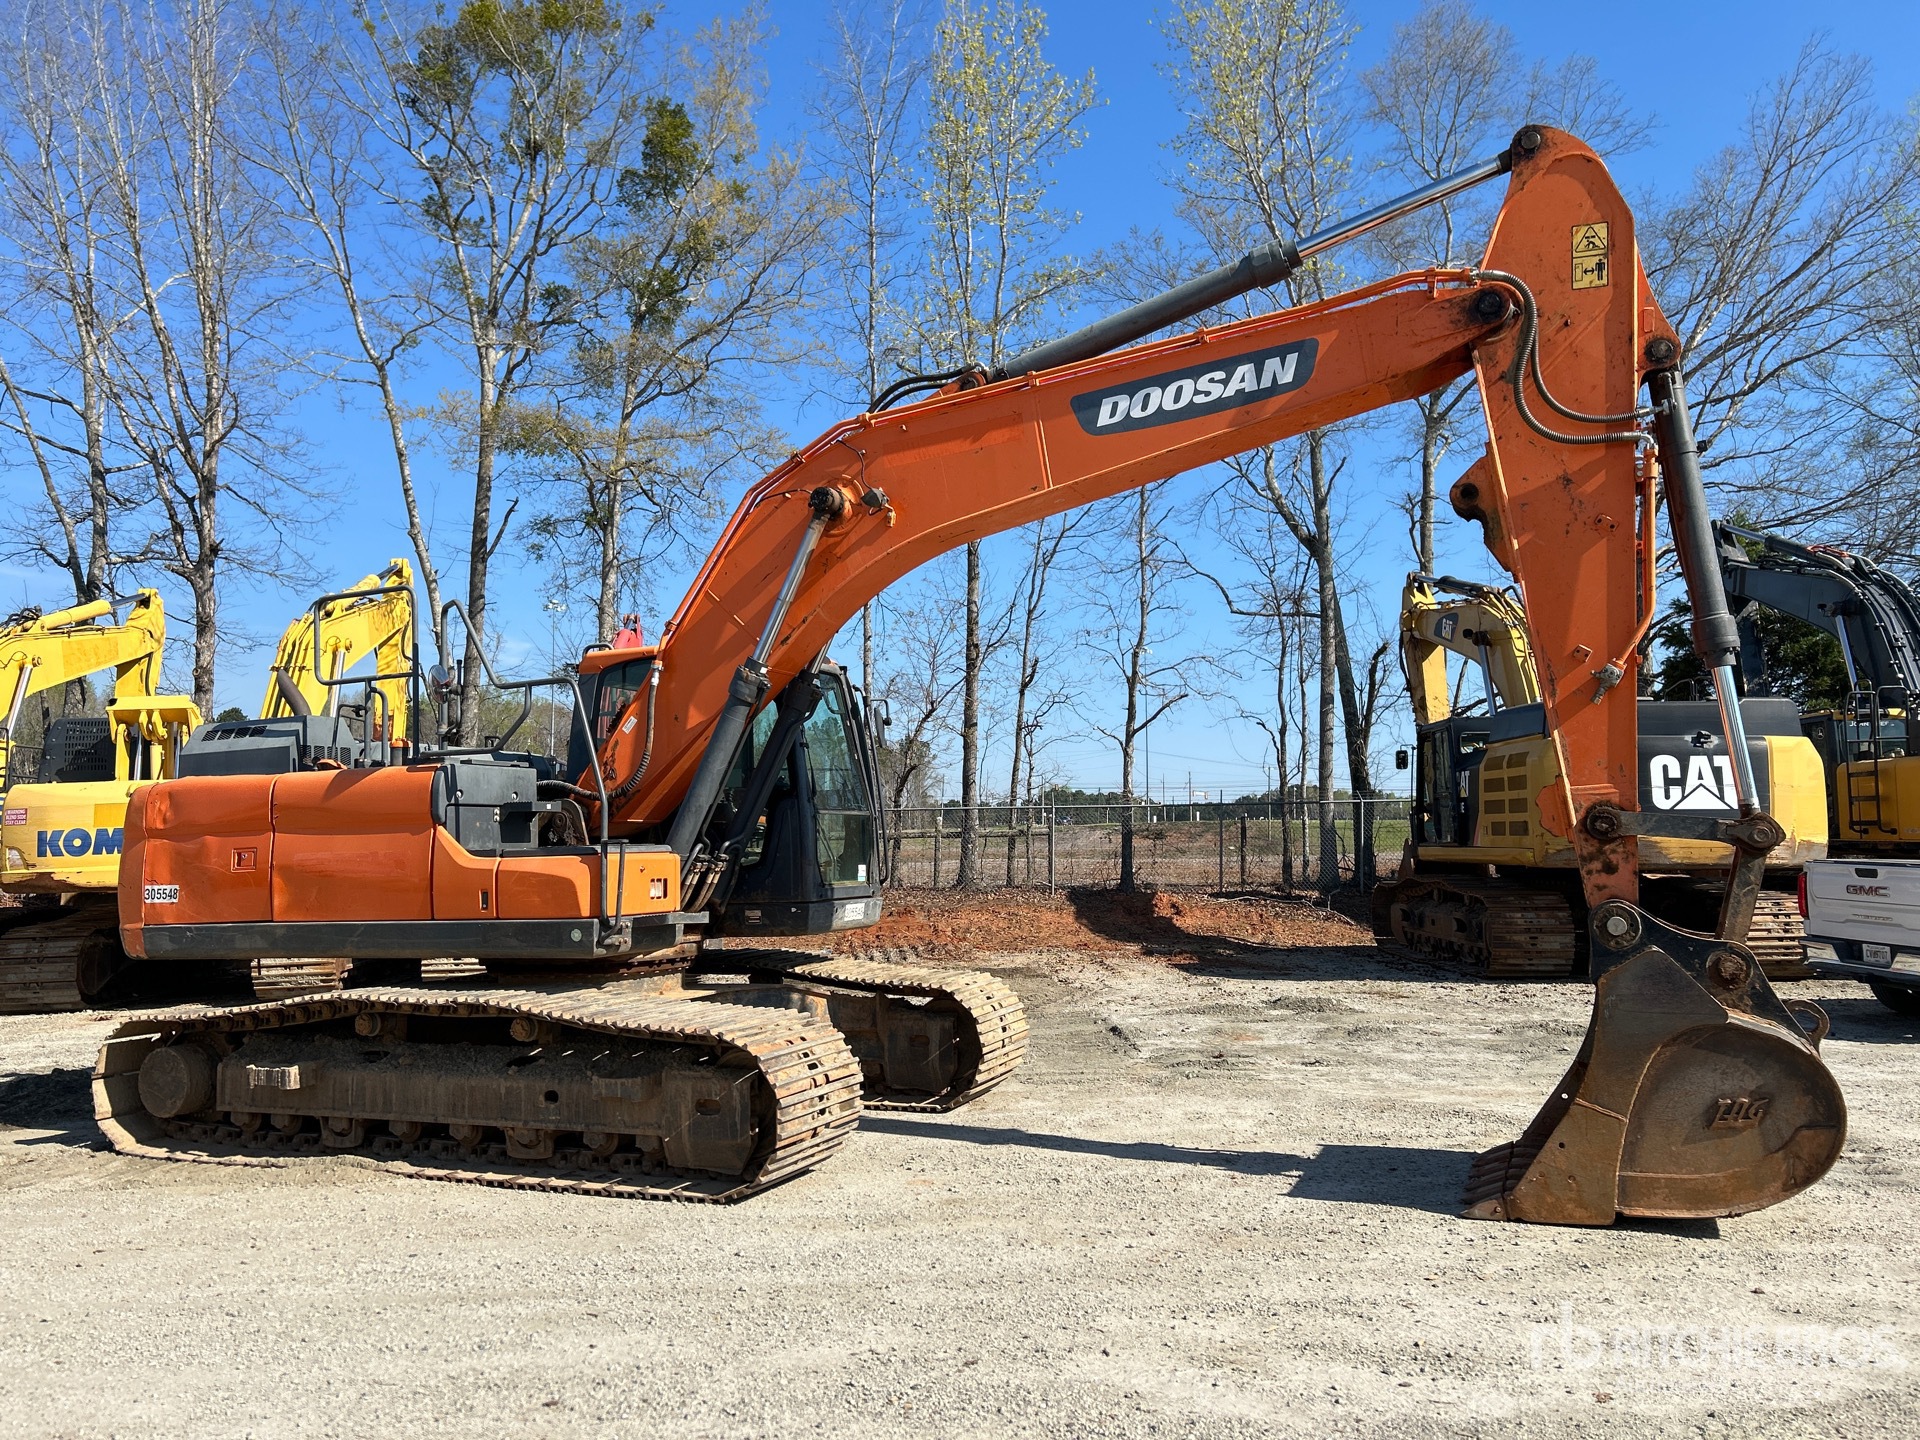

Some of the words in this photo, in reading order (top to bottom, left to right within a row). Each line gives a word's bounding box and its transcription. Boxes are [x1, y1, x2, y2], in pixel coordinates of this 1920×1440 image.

[1097, 352, 1299, 428] DOOSAN
[1650, 754, 1739, 810] CAT
[145, 888, 178, 900] 305548
[1846, 885, 1890, 898] GMC
